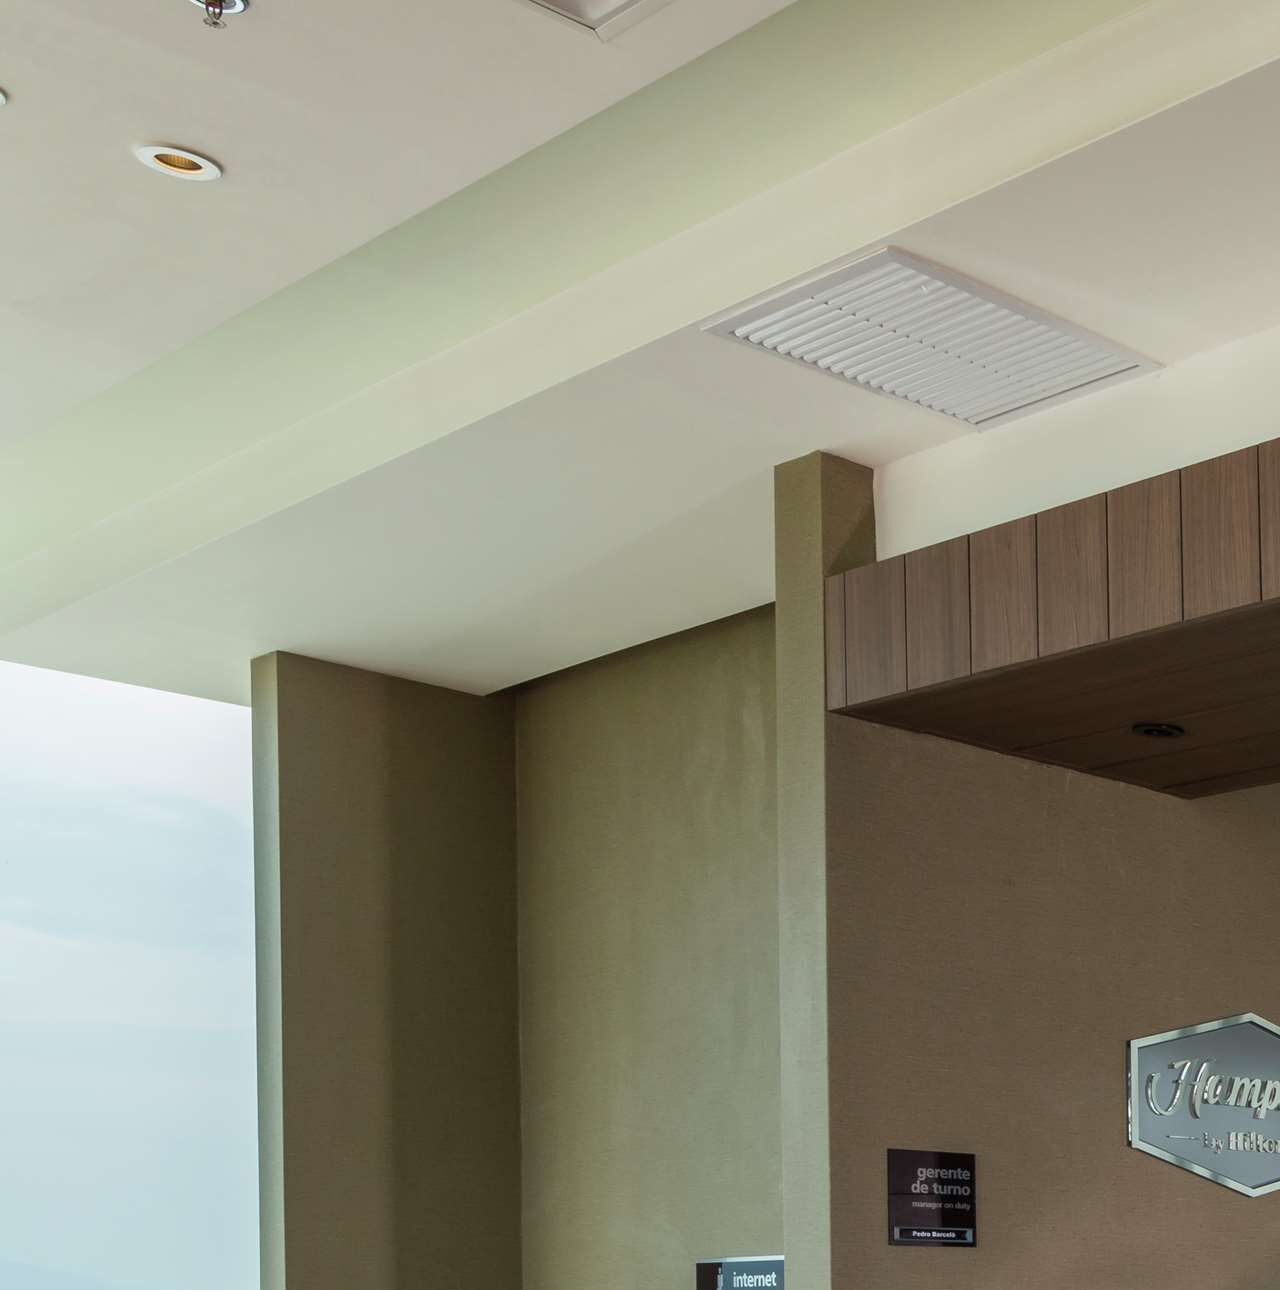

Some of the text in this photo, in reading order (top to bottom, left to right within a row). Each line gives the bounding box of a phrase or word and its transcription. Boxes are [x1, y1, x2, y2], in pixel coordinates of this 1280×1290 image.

[917, 1167, 971, 1181] gerente
[911, 1180, 971, 1196] de turno
[911, 1201, 943, 1210] manager
[912, 1230, 931, 1238] Pedro
[732, 1271, 777, 1288] internet
